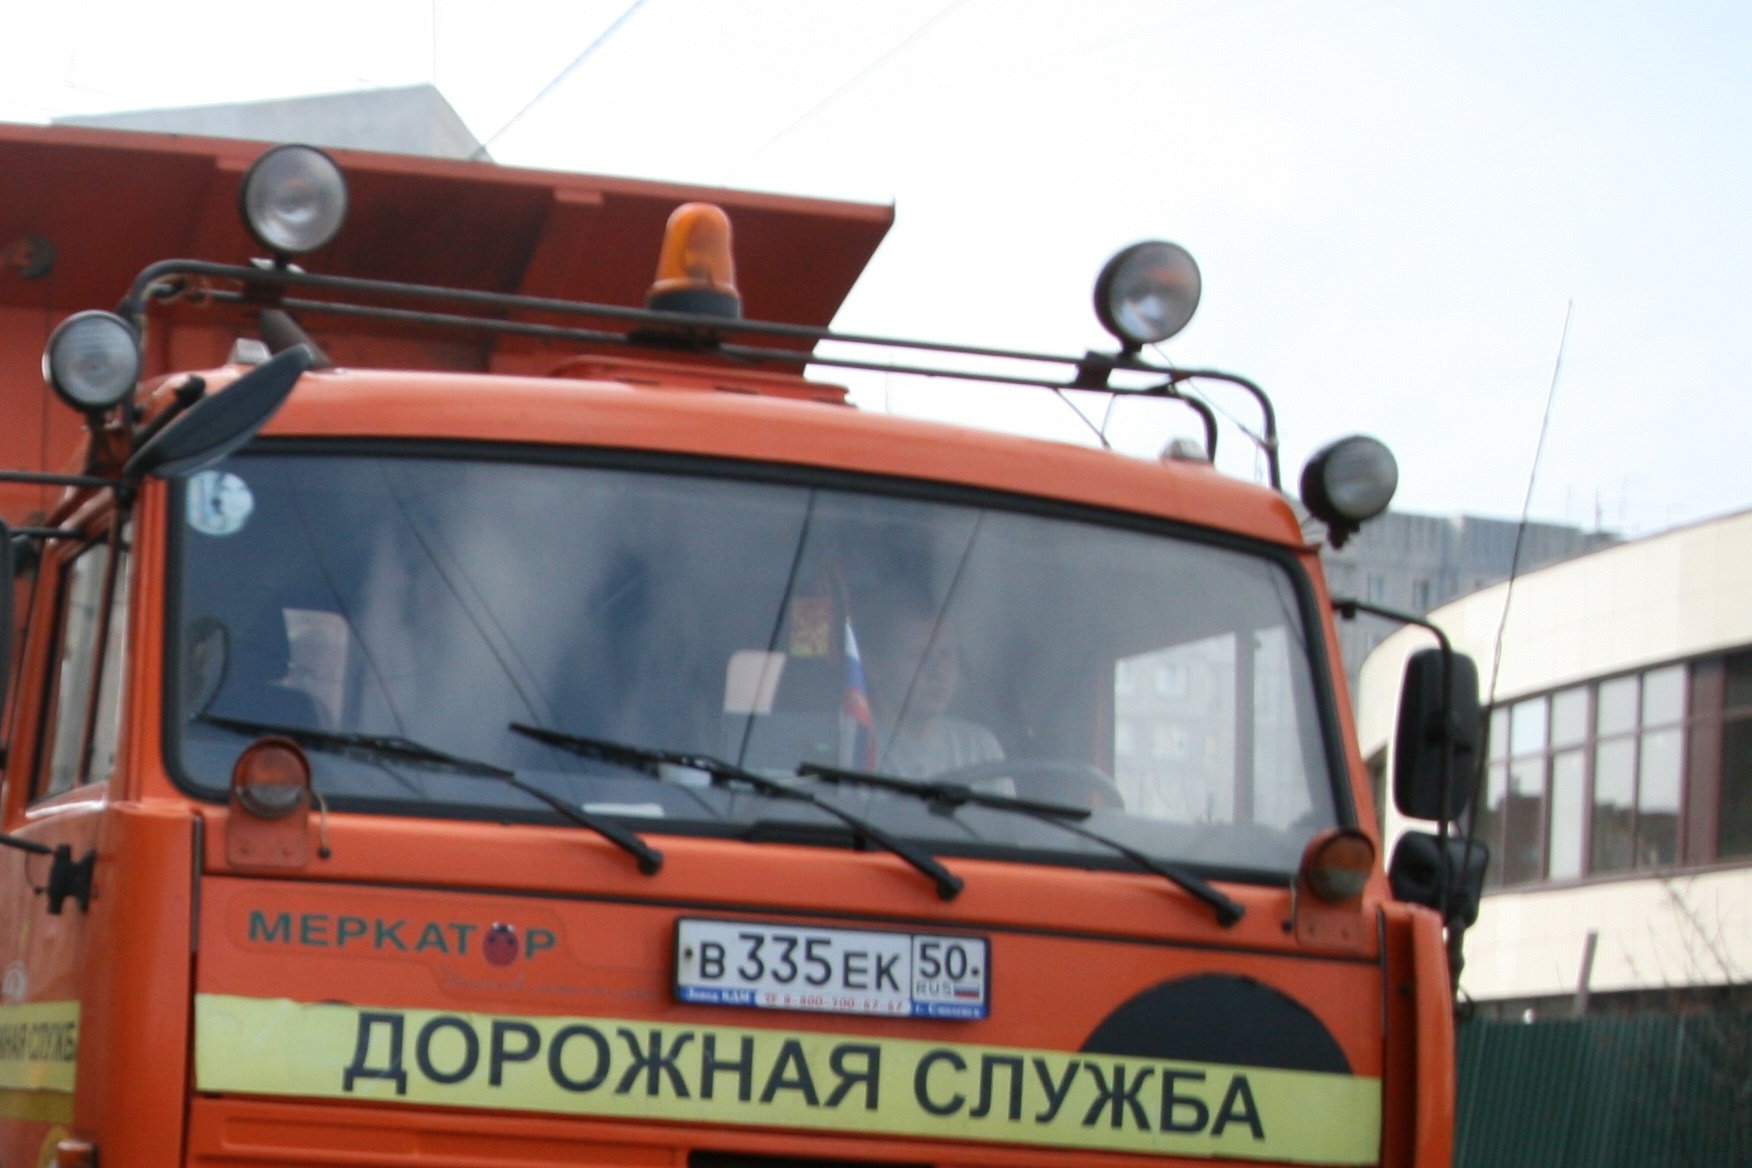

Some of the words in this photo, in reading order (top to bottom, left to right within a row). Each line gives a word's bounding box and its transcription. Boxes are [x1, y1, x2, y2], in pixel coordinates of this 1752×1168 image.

[919, 942, 968, 981] 50
[916, 980, 953, 998] RUS
[342, 1010, 883, 1111] ДОРОЖНАЯ
[913, 1047, 1266, 1140] СЛУЖБА
